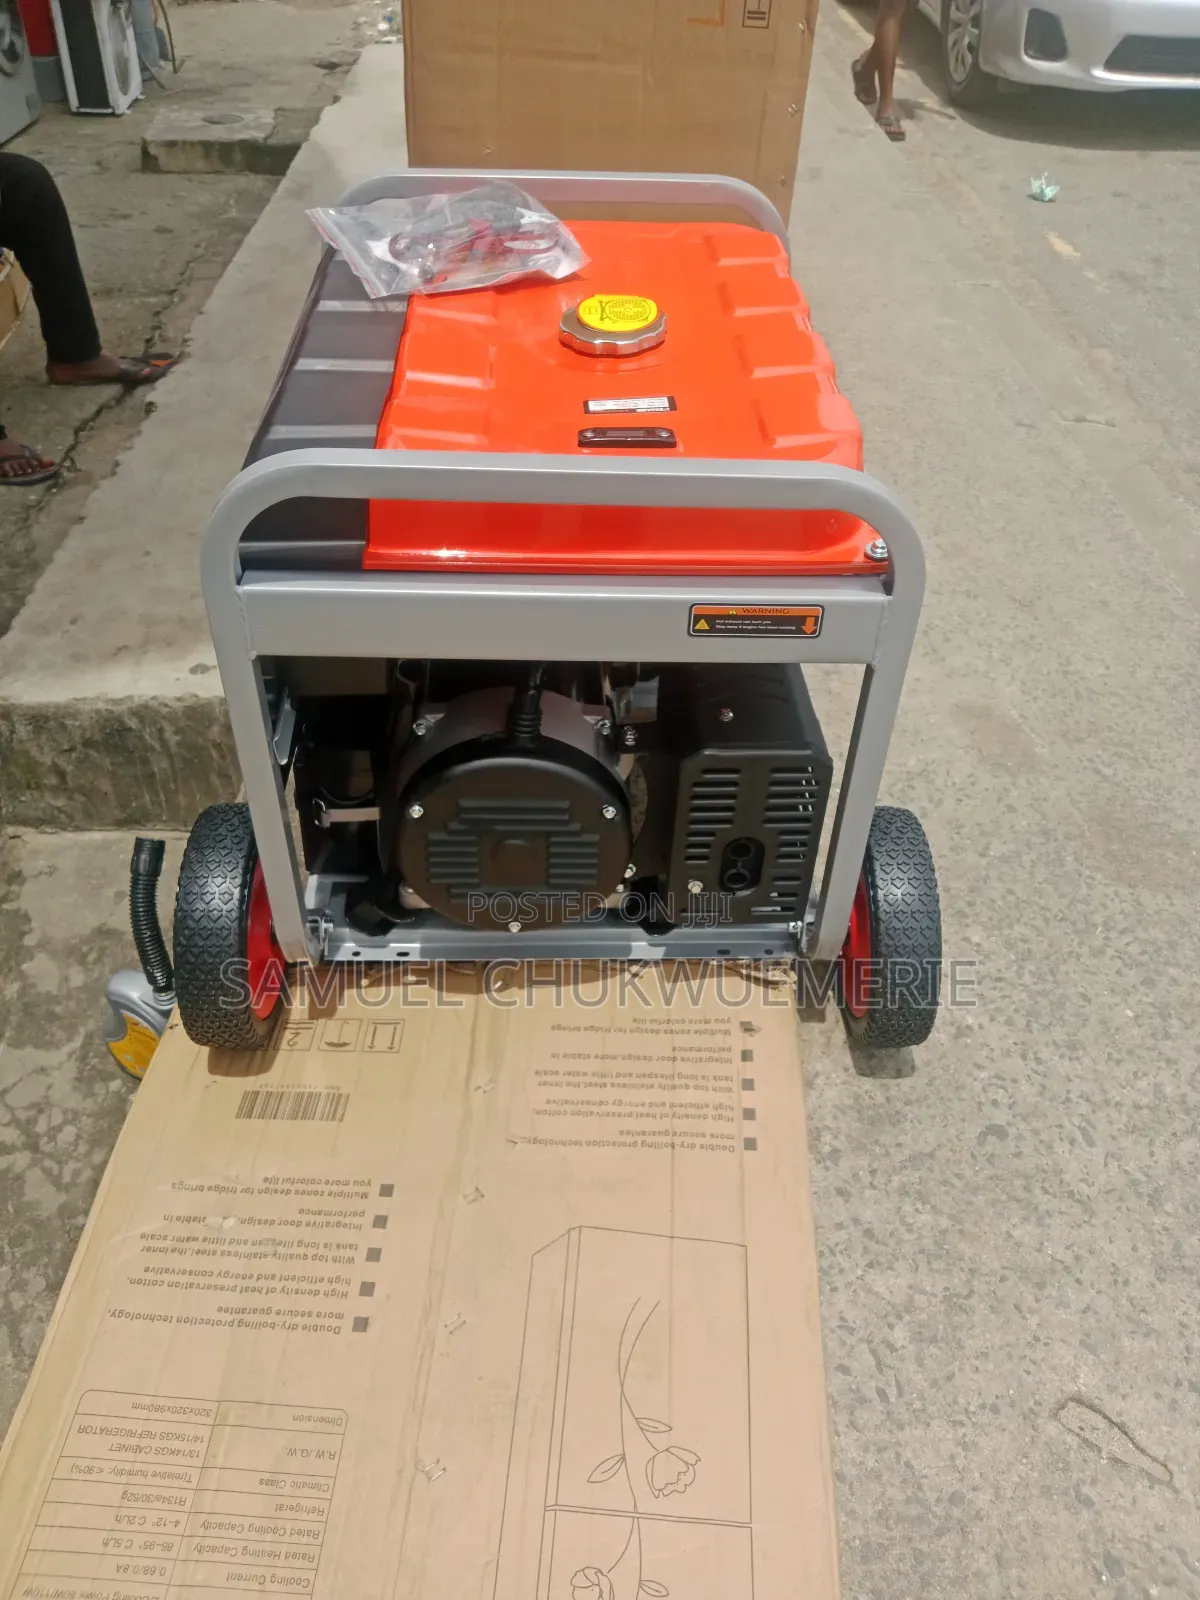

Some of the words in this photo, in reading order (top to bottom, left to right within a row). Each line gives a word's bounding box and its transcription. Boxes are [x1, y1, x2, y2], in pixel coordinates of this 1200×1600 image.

[742, 607, 790, 615] WARNING
[262, 1176, 280, 1184] life
[282, 1177, 322, 1186] colorful
[353, 1178, 372, 1187] you
[171, 1181, 205, 1193] brings
[207, 1184, 238, 1194] fridge
[239, 1187, 255, 1195] for
[257, 1186, 292, 1197] design
[294, 1189, 325, 1197] zones
[327, 1189, 369, 1200] Multiple
[163, 1214, 174, 1223] in
[298, 1208, 366, 1218] performance
[237, 1217, 276, 1227] design,
[278, 1220, 303, 1229] door
[305, 1220, 363, 1231] Integrative
[139, 1232, 169, 1241] scale
[169, 1235, 200, 1243] water
[201, 1236, 226, 1246] little
[228, 1238, 249, 1247] and
[251, 1239, 294, 1249] lifean
[297, 1239, 320, 1250] long
[323, 1242, 333, 1251] is
[335, 1243, 358, 1251] tank
[140, 1245, 169, 1255] inner
[311, 1252, 329, 1263] top
[331, 1254, 355, 1265] With
[143, 1266, 214, 1279] conservative
[216, 1269, 254, 1281] energy
[256, 1273, 277, 1281] and
[126, 1277, 165, 1287] cotton,
[279, 1274, 325, 1284] efficient
[327, 1275, 351, 1286] high
[167, 1280, 238, 1293] preservation
[239, 1285, 264, 1295] heat
[265, 1286, 277, 1296] of
[279, 1286, 320, 1297] density
[323, 1288, 348, 1299] High
[216, 1305, 273, 1315] guarantee
[275, 1308, 313, 1317] secure
[315, 1311, 344, 1320] more
[107, 1308, 174, 1324] technology,
[176, 1315, 235, 1328] protection
[237, 1319, 299, 1332] dry-boiling
[301, 1324, 341, 1335] Double
[131, 1402, 212, 1418] 320x320x980mm
[292, 1413, 343, 1427] Dimension
[77, 1424, 157, 1440] REFRIGERATOR
[158, 1431, 205, 1443] 14/15KGS
[107, 1442, 152, 1454] CABINET
[154, 1446, 200, 1459] 13/14KGS
[258, 1478, 287, 1489] Class
[289, 1480, 330, 1493] Climatic
[274, 1502, 325, 1517] Refrigerat
[200, 1519, 245, 1534] Capacity
[248, 1522, 286, 1537] Cooling
[289, 1528, 320, 1540] Rated
[193, 1542, 238, 1557] Capacity
[241, 1546, 282, 1560] Heating
[284, 1551, 316, 1563] Rated
[226, 1572, 267, 1585] Current
[270, 1573, 310, 1588] Cooling
